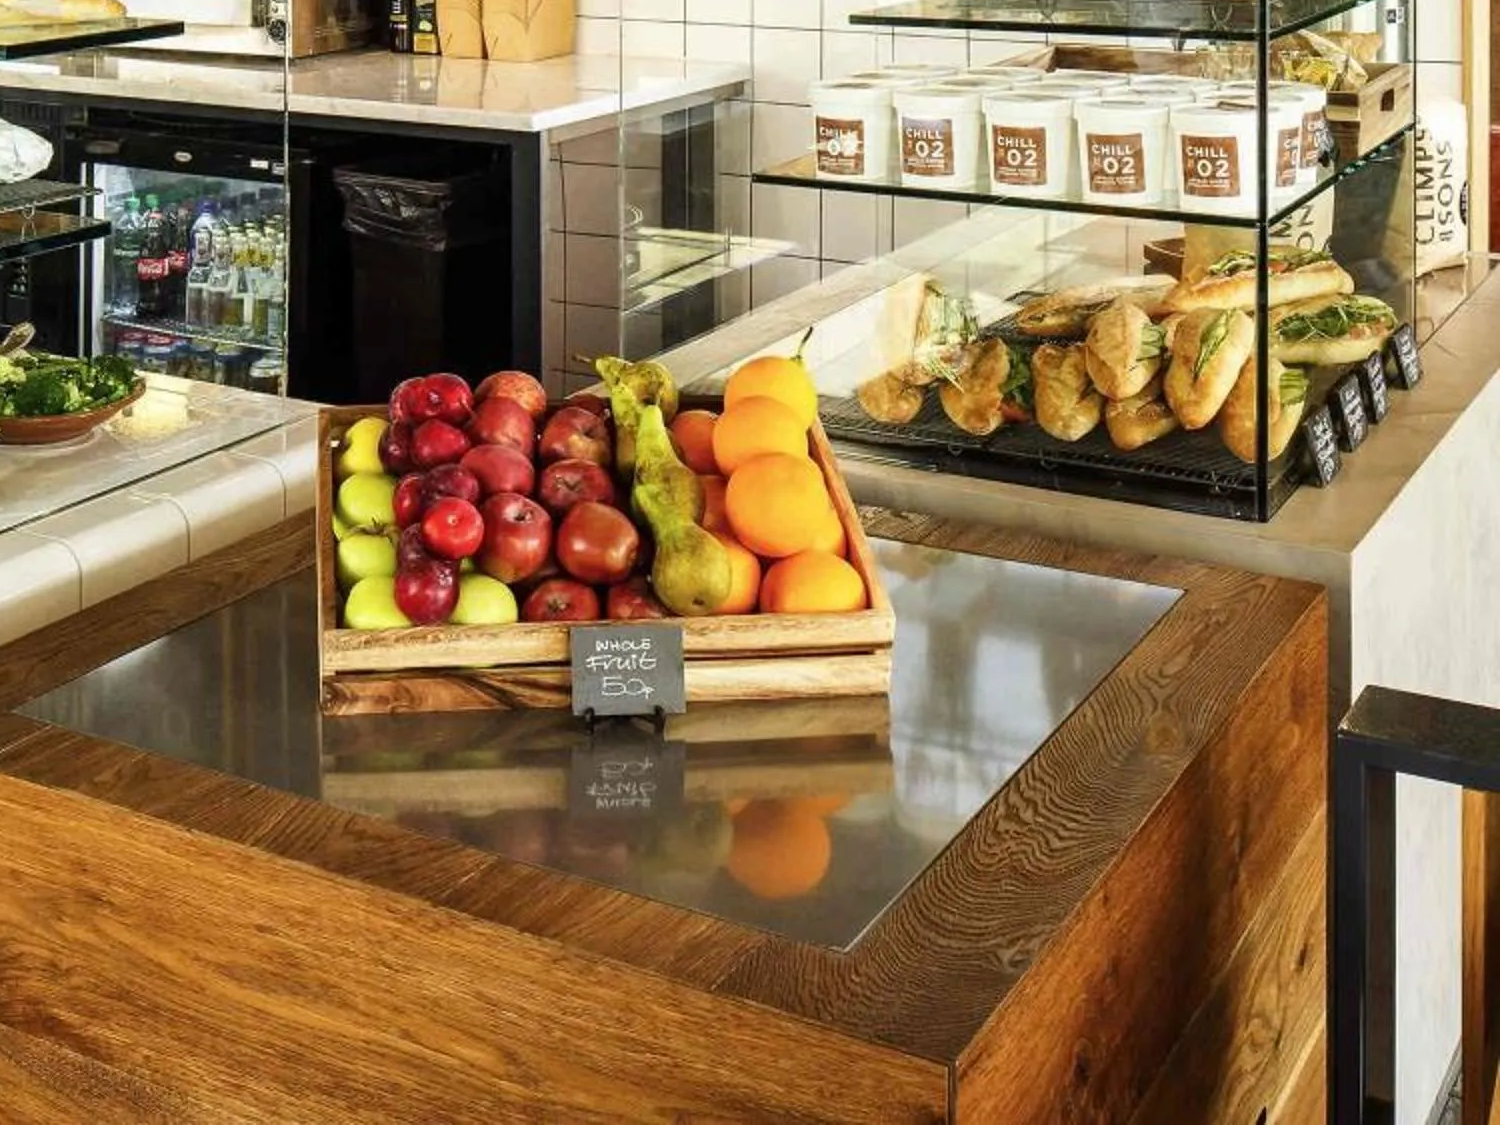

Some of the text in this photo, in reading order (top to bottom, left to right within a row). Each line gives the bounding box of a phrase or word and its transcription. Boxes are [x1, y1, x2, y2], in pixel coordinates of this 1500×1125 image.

[905, 127, 944, 140] CHILL
[997, 136, 1037, 149] CHILL
[915, 140, 945, 159] 02
[1007, 148, 1038, 166] 02
[1091, 144, 1133, 157] CHILL
[1186, 146, 1229, 158] CHILL
[1103, 156, 1136, 175] 02
[1197, 159, 1231, 178] 02
[1415, 127, 1435, 246] CLIMPS
[595, 638, 651, 651] WHOLE
[586, 652, 657, 672] Fruit
[601, 676, 655, 700] 50p
